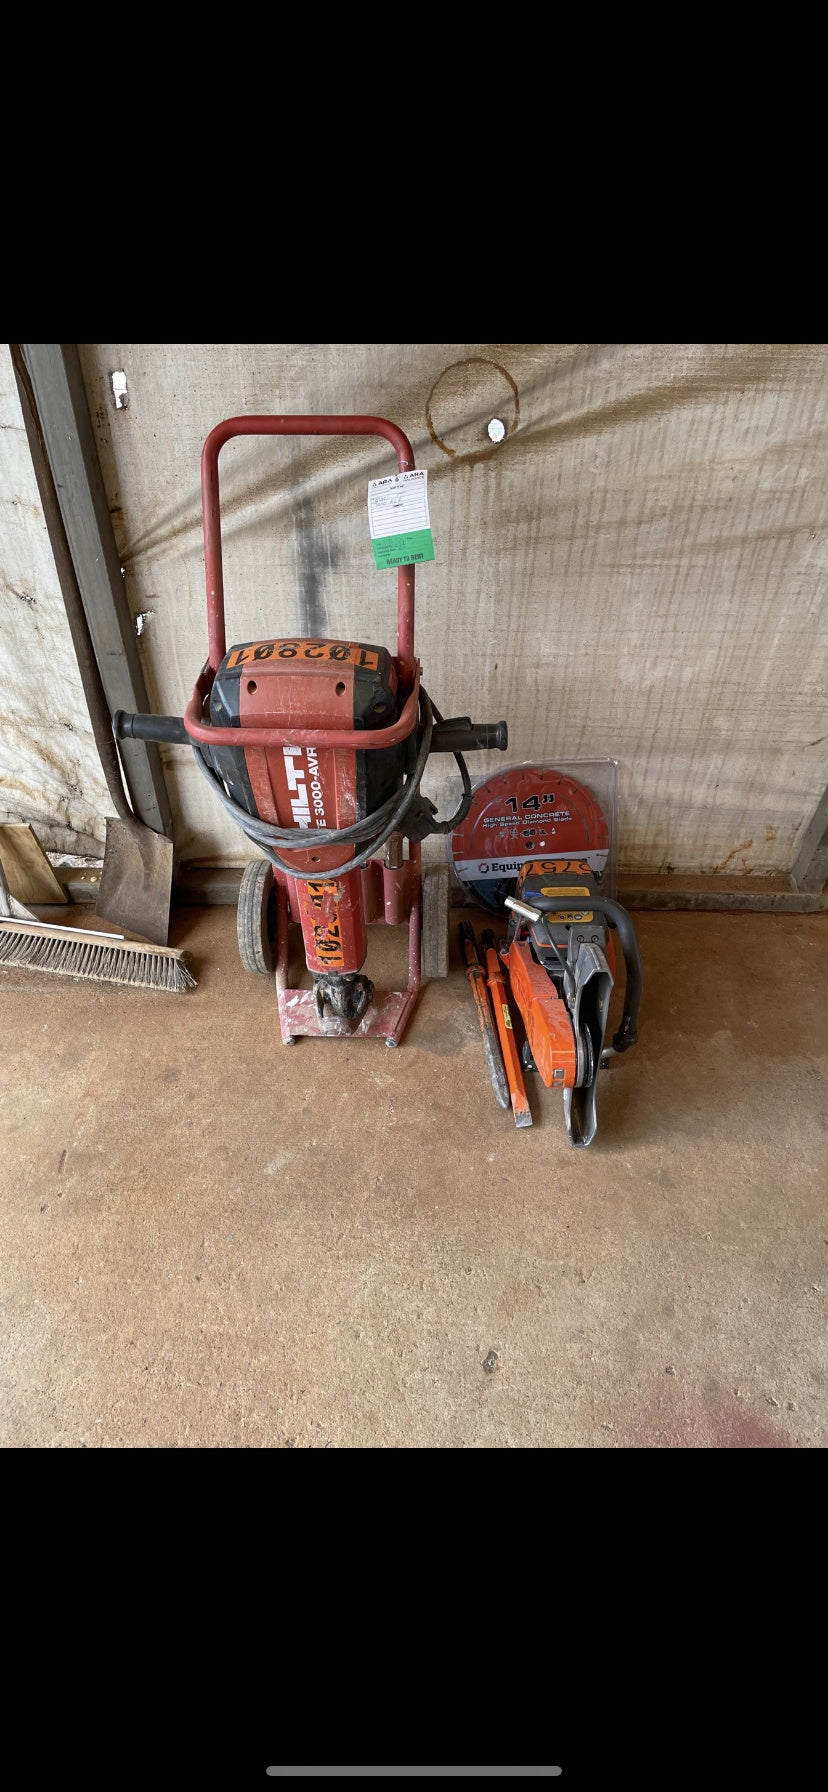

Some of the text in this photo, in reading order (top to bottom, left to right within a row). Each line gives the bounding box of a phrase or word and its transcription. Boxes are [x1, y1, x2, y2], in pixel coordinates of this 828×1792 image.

[386, 557, 402, 565] READY
[483, 811, 571, 823] GENERAL CONCRETE
